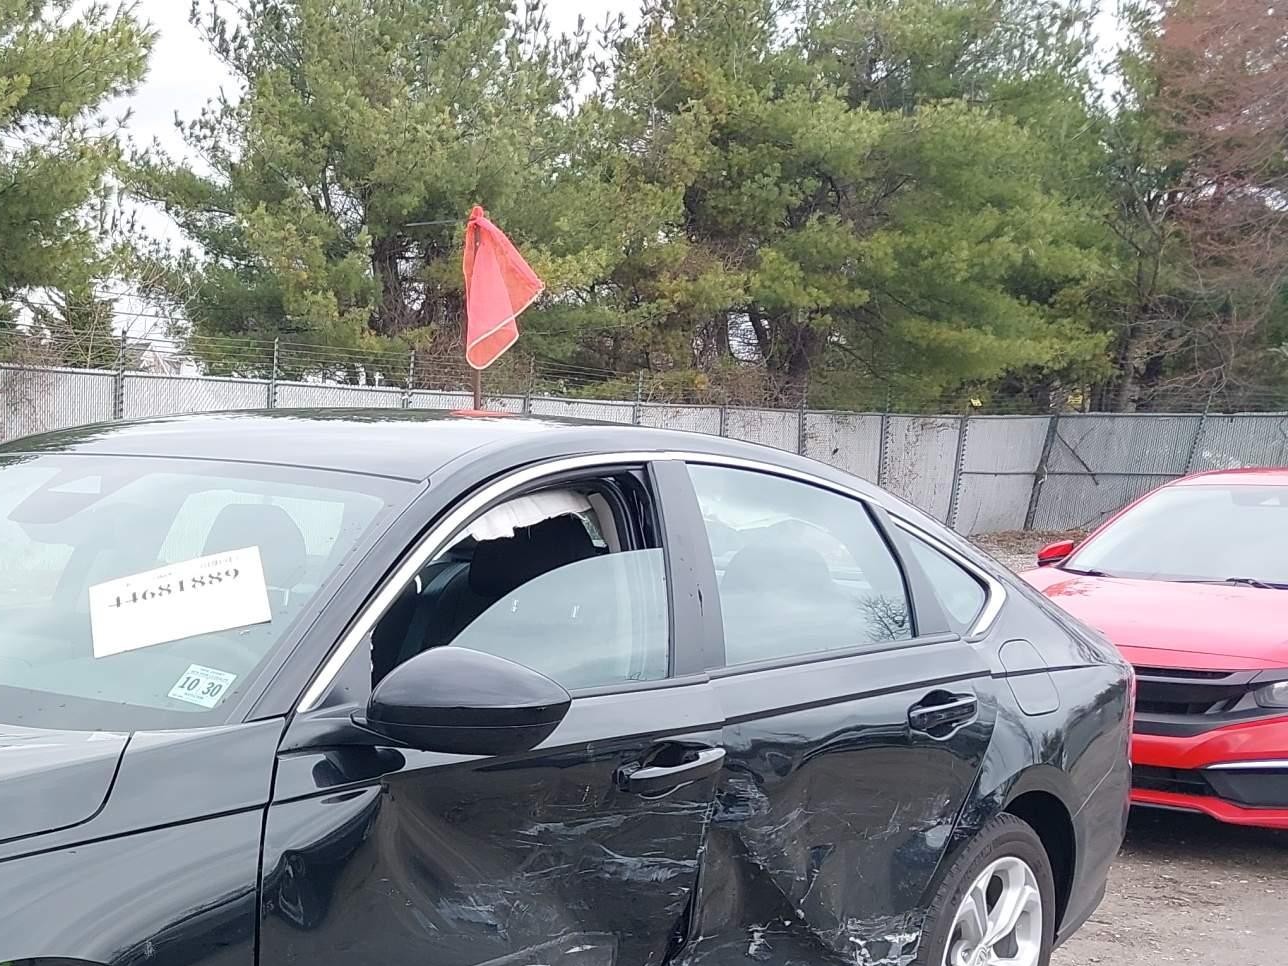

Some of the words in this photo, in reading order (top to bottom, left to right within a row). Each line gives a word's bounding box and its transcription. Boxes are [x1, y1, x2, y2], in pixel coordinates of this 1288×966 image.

[106, 568, 240, 608] 44681889
[178, 676, 201, 691] 10
[201, 682, 223, 697] 30
